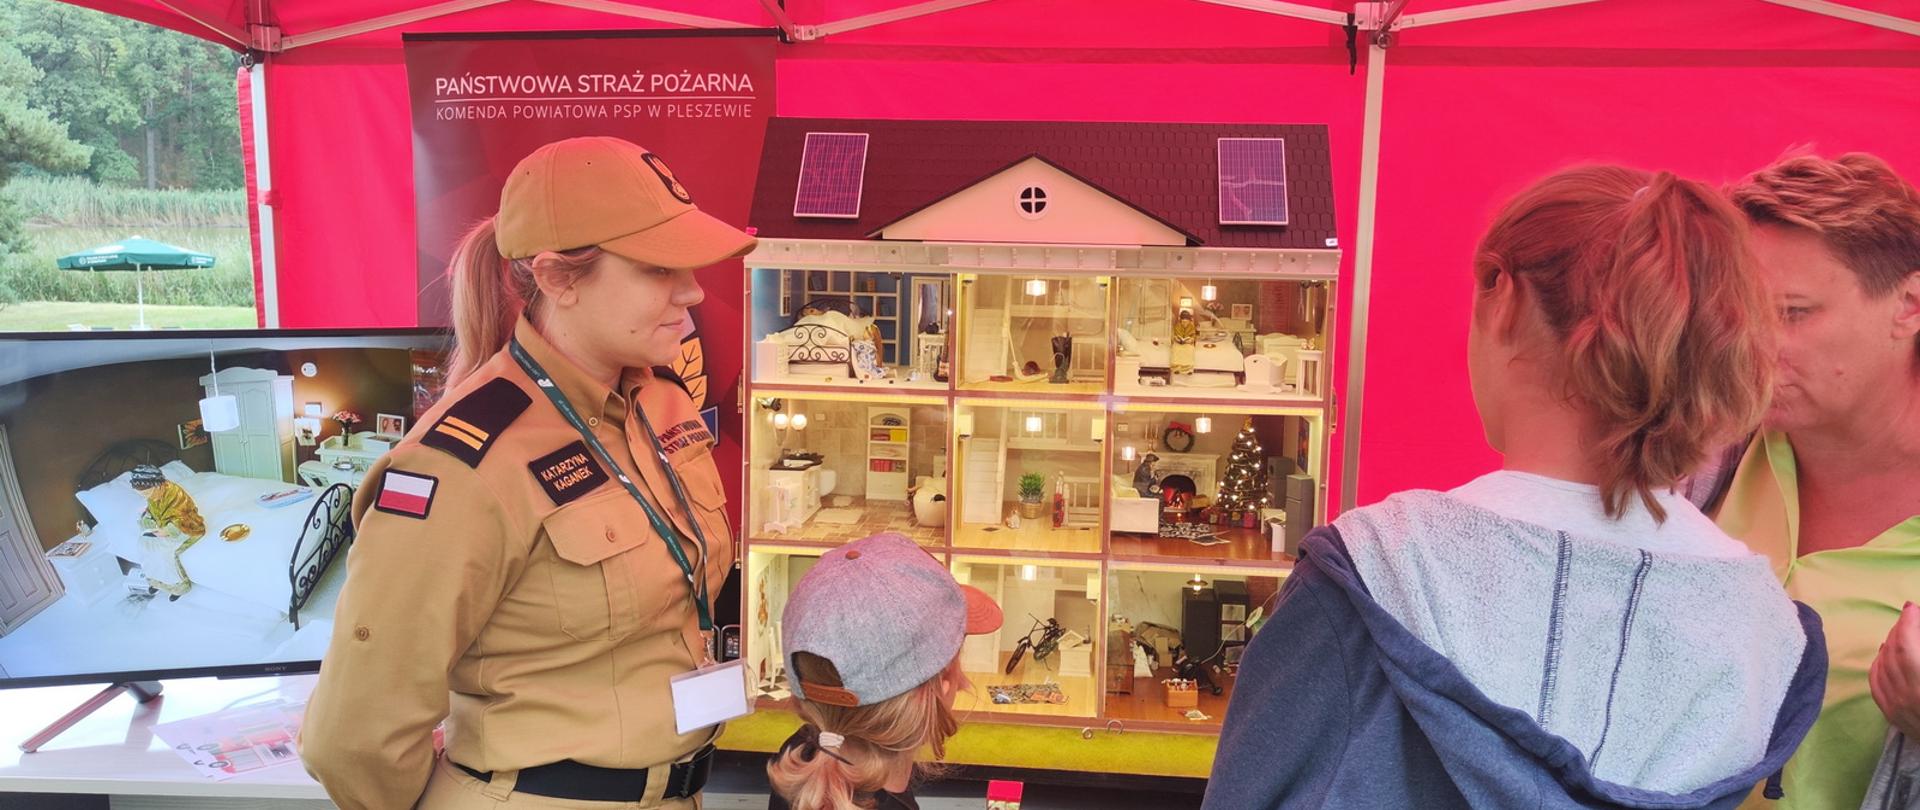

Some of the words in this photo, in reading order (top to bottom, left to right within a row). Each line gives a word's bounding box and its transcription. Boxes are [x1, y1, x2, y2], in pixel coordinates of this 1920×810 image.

[435, 72, 573, 96] PAŃSTWOWA
[577, 69, 645, 94] STRAŻ
[651, 69, 754, 93] POŻARNA
[436, 105, 507, 121] KOMENDA
[513, 104, 608, 119] POWIATOWA
[613, 104, 642, 118] PSP
[647, 104, 661, 118] W
[667, 103, 752, 118] PLESZEWIE
[540, 453, 589, 482] KATARZYNA
[552, 466, 594, 492] KAGANEK
